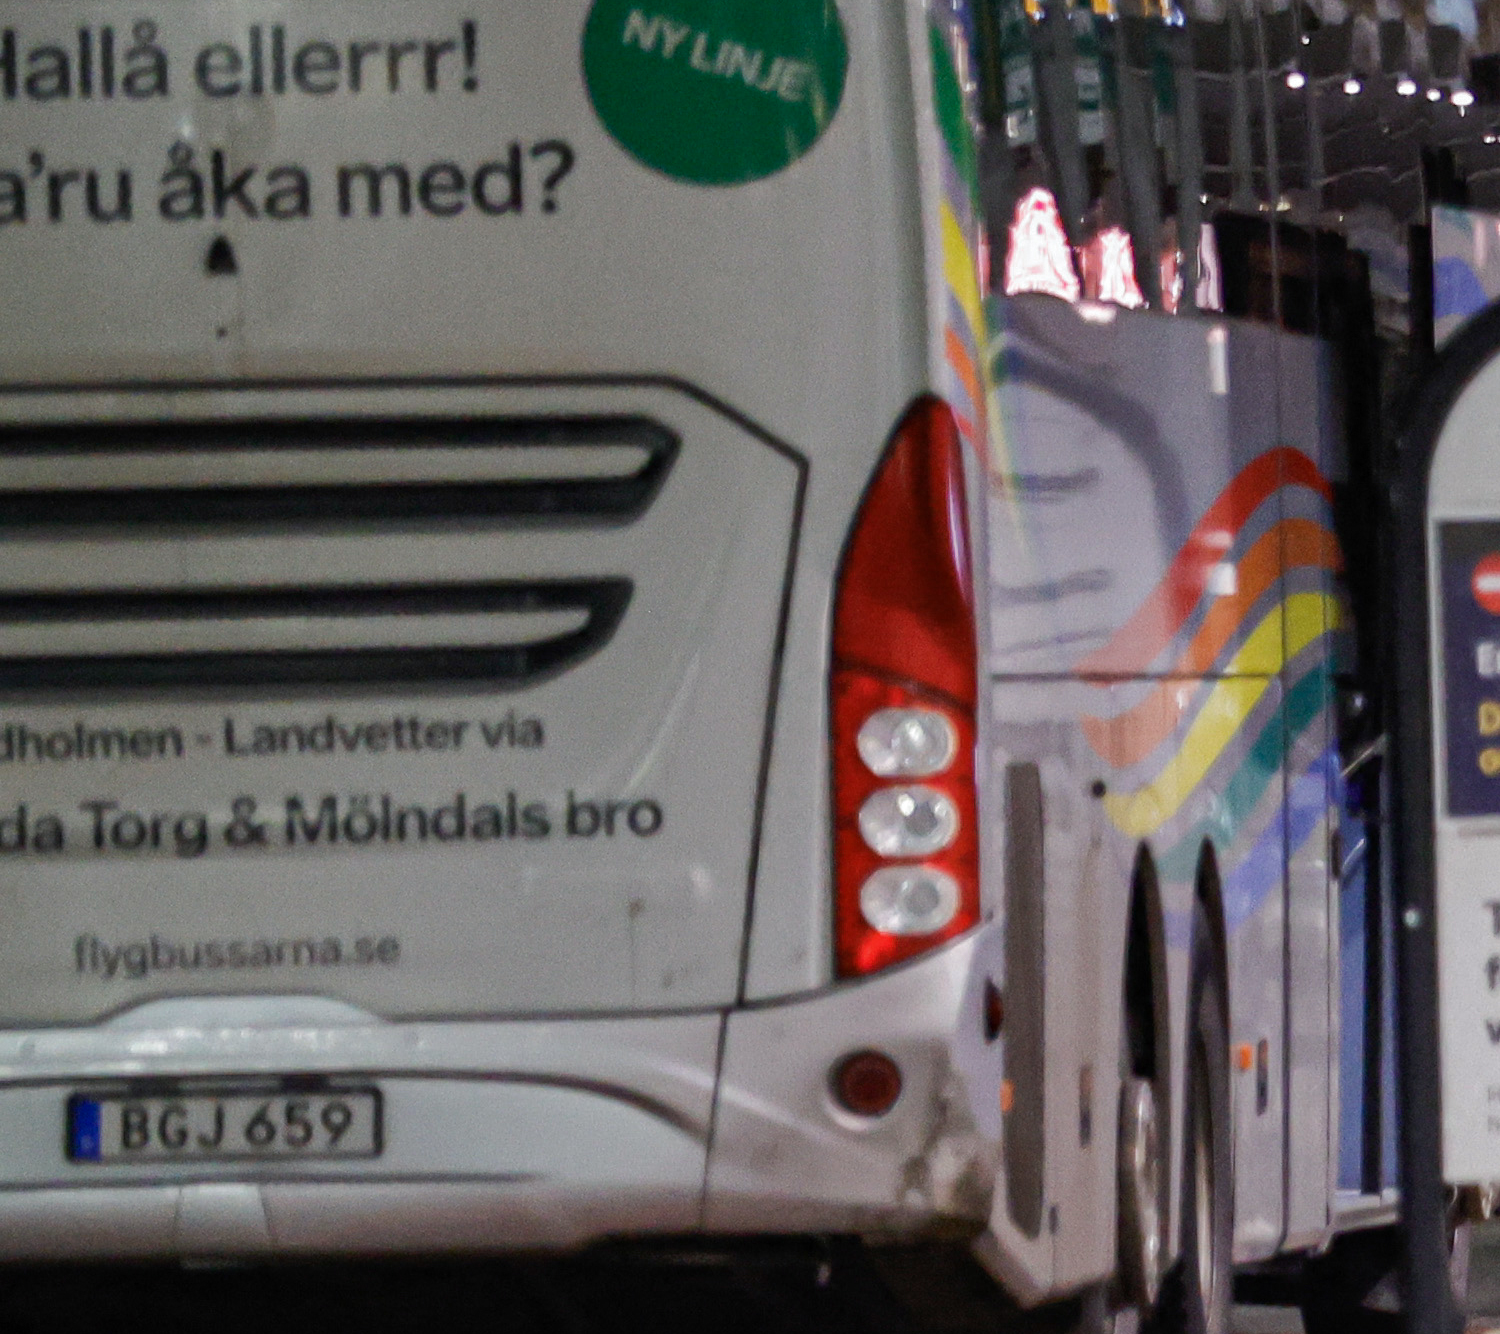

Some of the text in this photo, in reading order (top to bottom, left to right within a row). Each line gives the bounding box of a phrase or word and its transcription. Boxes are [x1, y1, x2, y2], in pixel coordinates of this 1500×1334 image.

[194, 19, 480, 98] ellerrr!
[621, 8, 810, 103] NY LINJE
[158, 139, 312, 222] åka
[335, 137, 577, 218] med?
[224, 716, 468, 756] Landvetter
[480, 710, 546, 749] via
[79, 798, 208, 859] Torg
[223, 794, 268, 847] &
[285, 791, 552, 846] Mölndals
[566, 789, 663, 839] bro
[72, 932, 402, 980] flygbussarna.se
[119, 1100, 354, 1151] BGJ 659
